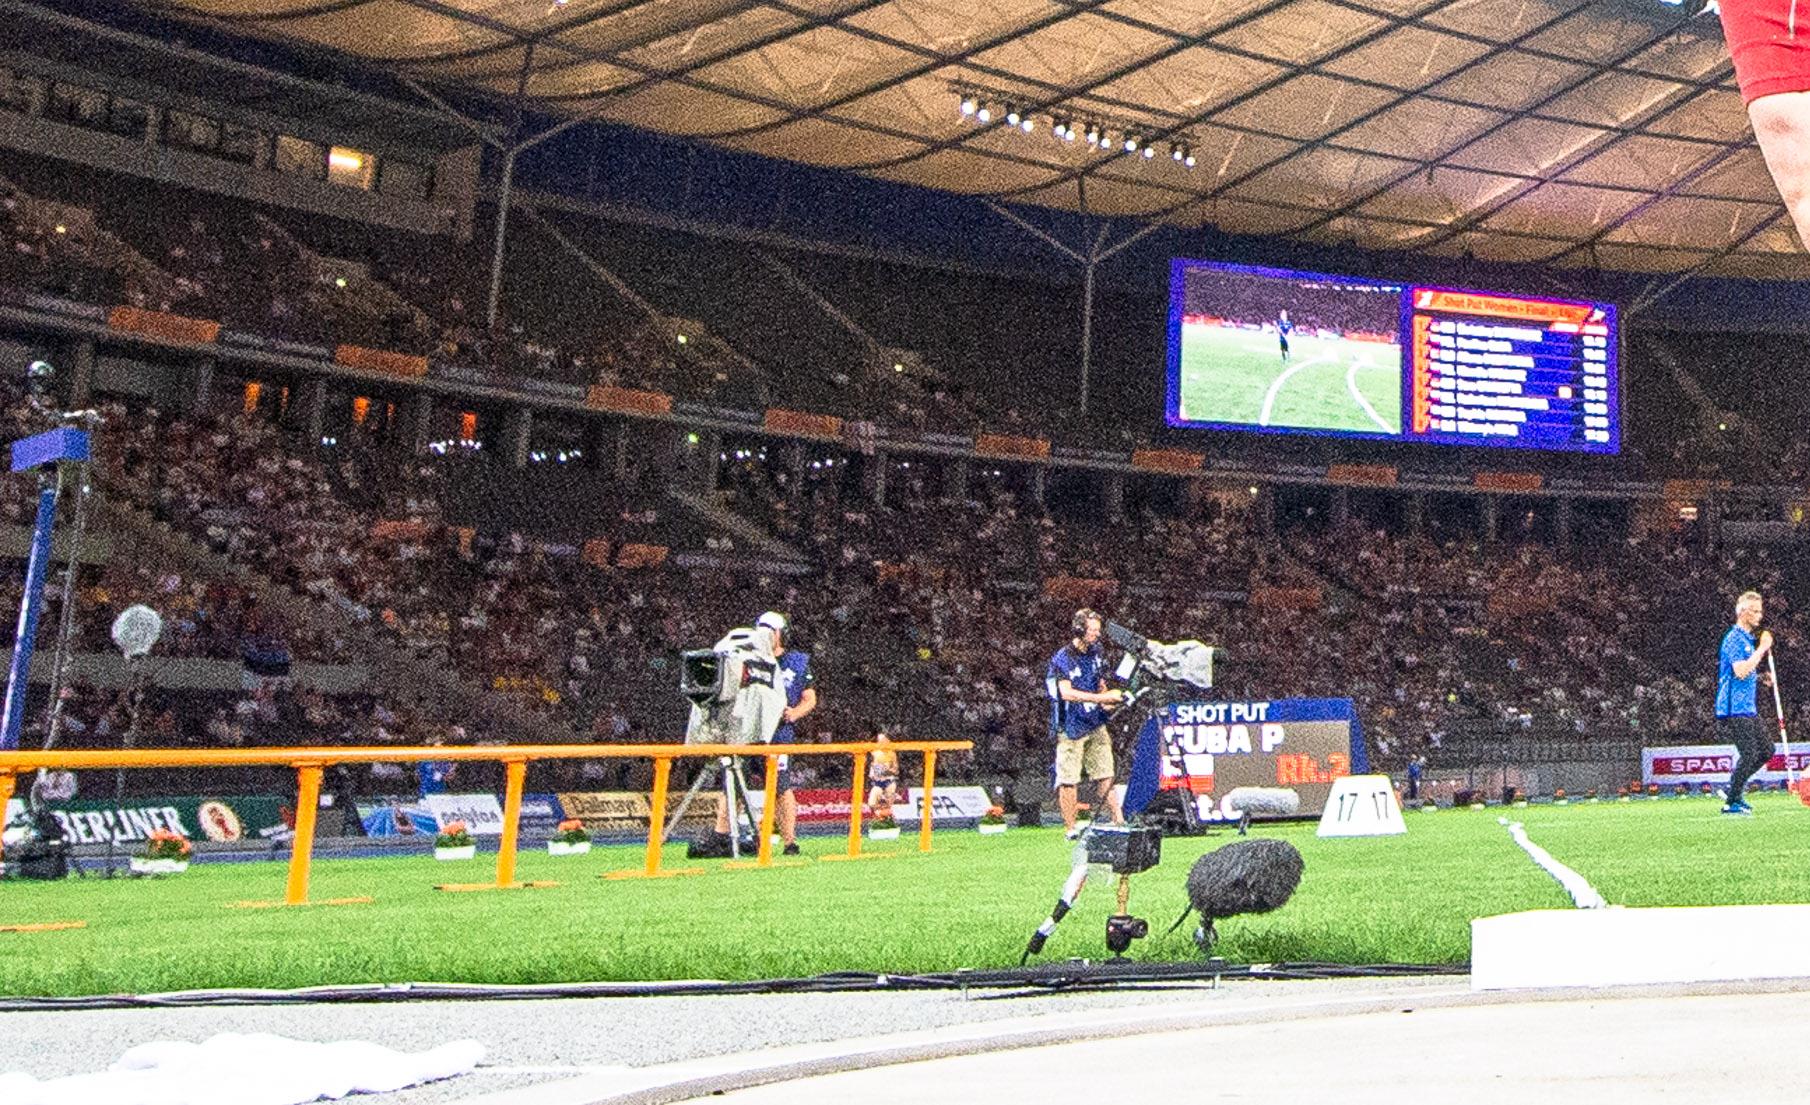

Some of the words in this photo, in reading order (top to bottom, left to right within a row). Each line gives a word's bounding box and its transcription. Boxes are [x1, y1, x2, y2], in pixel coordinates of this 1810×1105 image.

[1484, 300, 1518, 314] Women
[1176, 703, 1228, 724] SHOT
[1231, 701, 1270, 722] PUT
[1261, 723, 1285, 753] P
[1670, 758, 1732, 773] SPAR
[569, 795, 636, 817] Dallmayr
[1338, 792, 1358, 822] 17
[1371, 791, 1388, 820] 17
